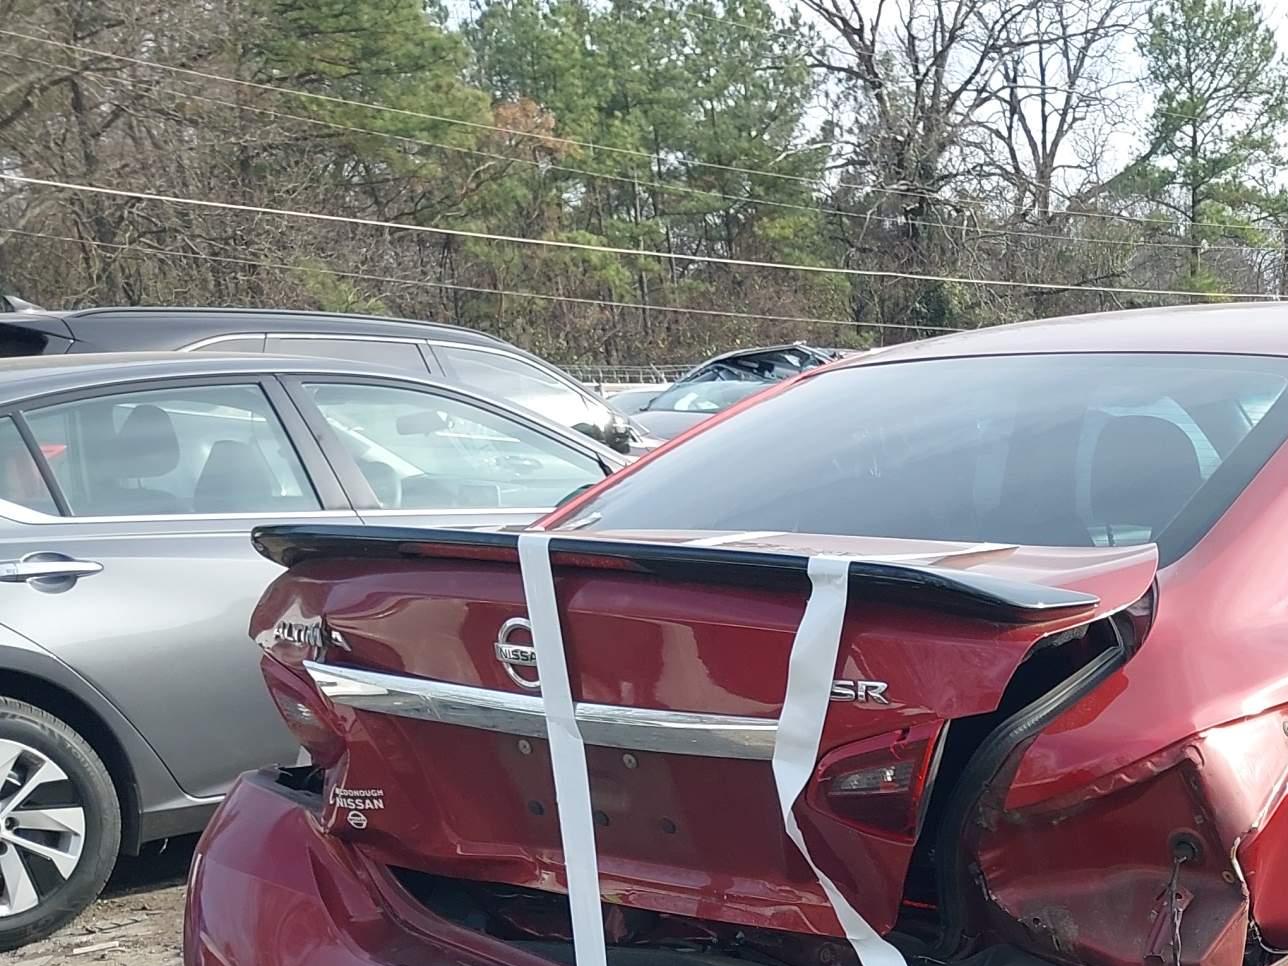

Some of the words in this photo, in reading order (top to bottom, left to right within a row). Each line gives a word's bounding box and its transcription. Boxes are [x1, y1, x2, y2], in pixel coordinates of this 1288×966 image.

[499, 648, 537, 662] NISSA
[830, 680, 889, 704] SR
[335, 796, 385, 810] NISSAN
